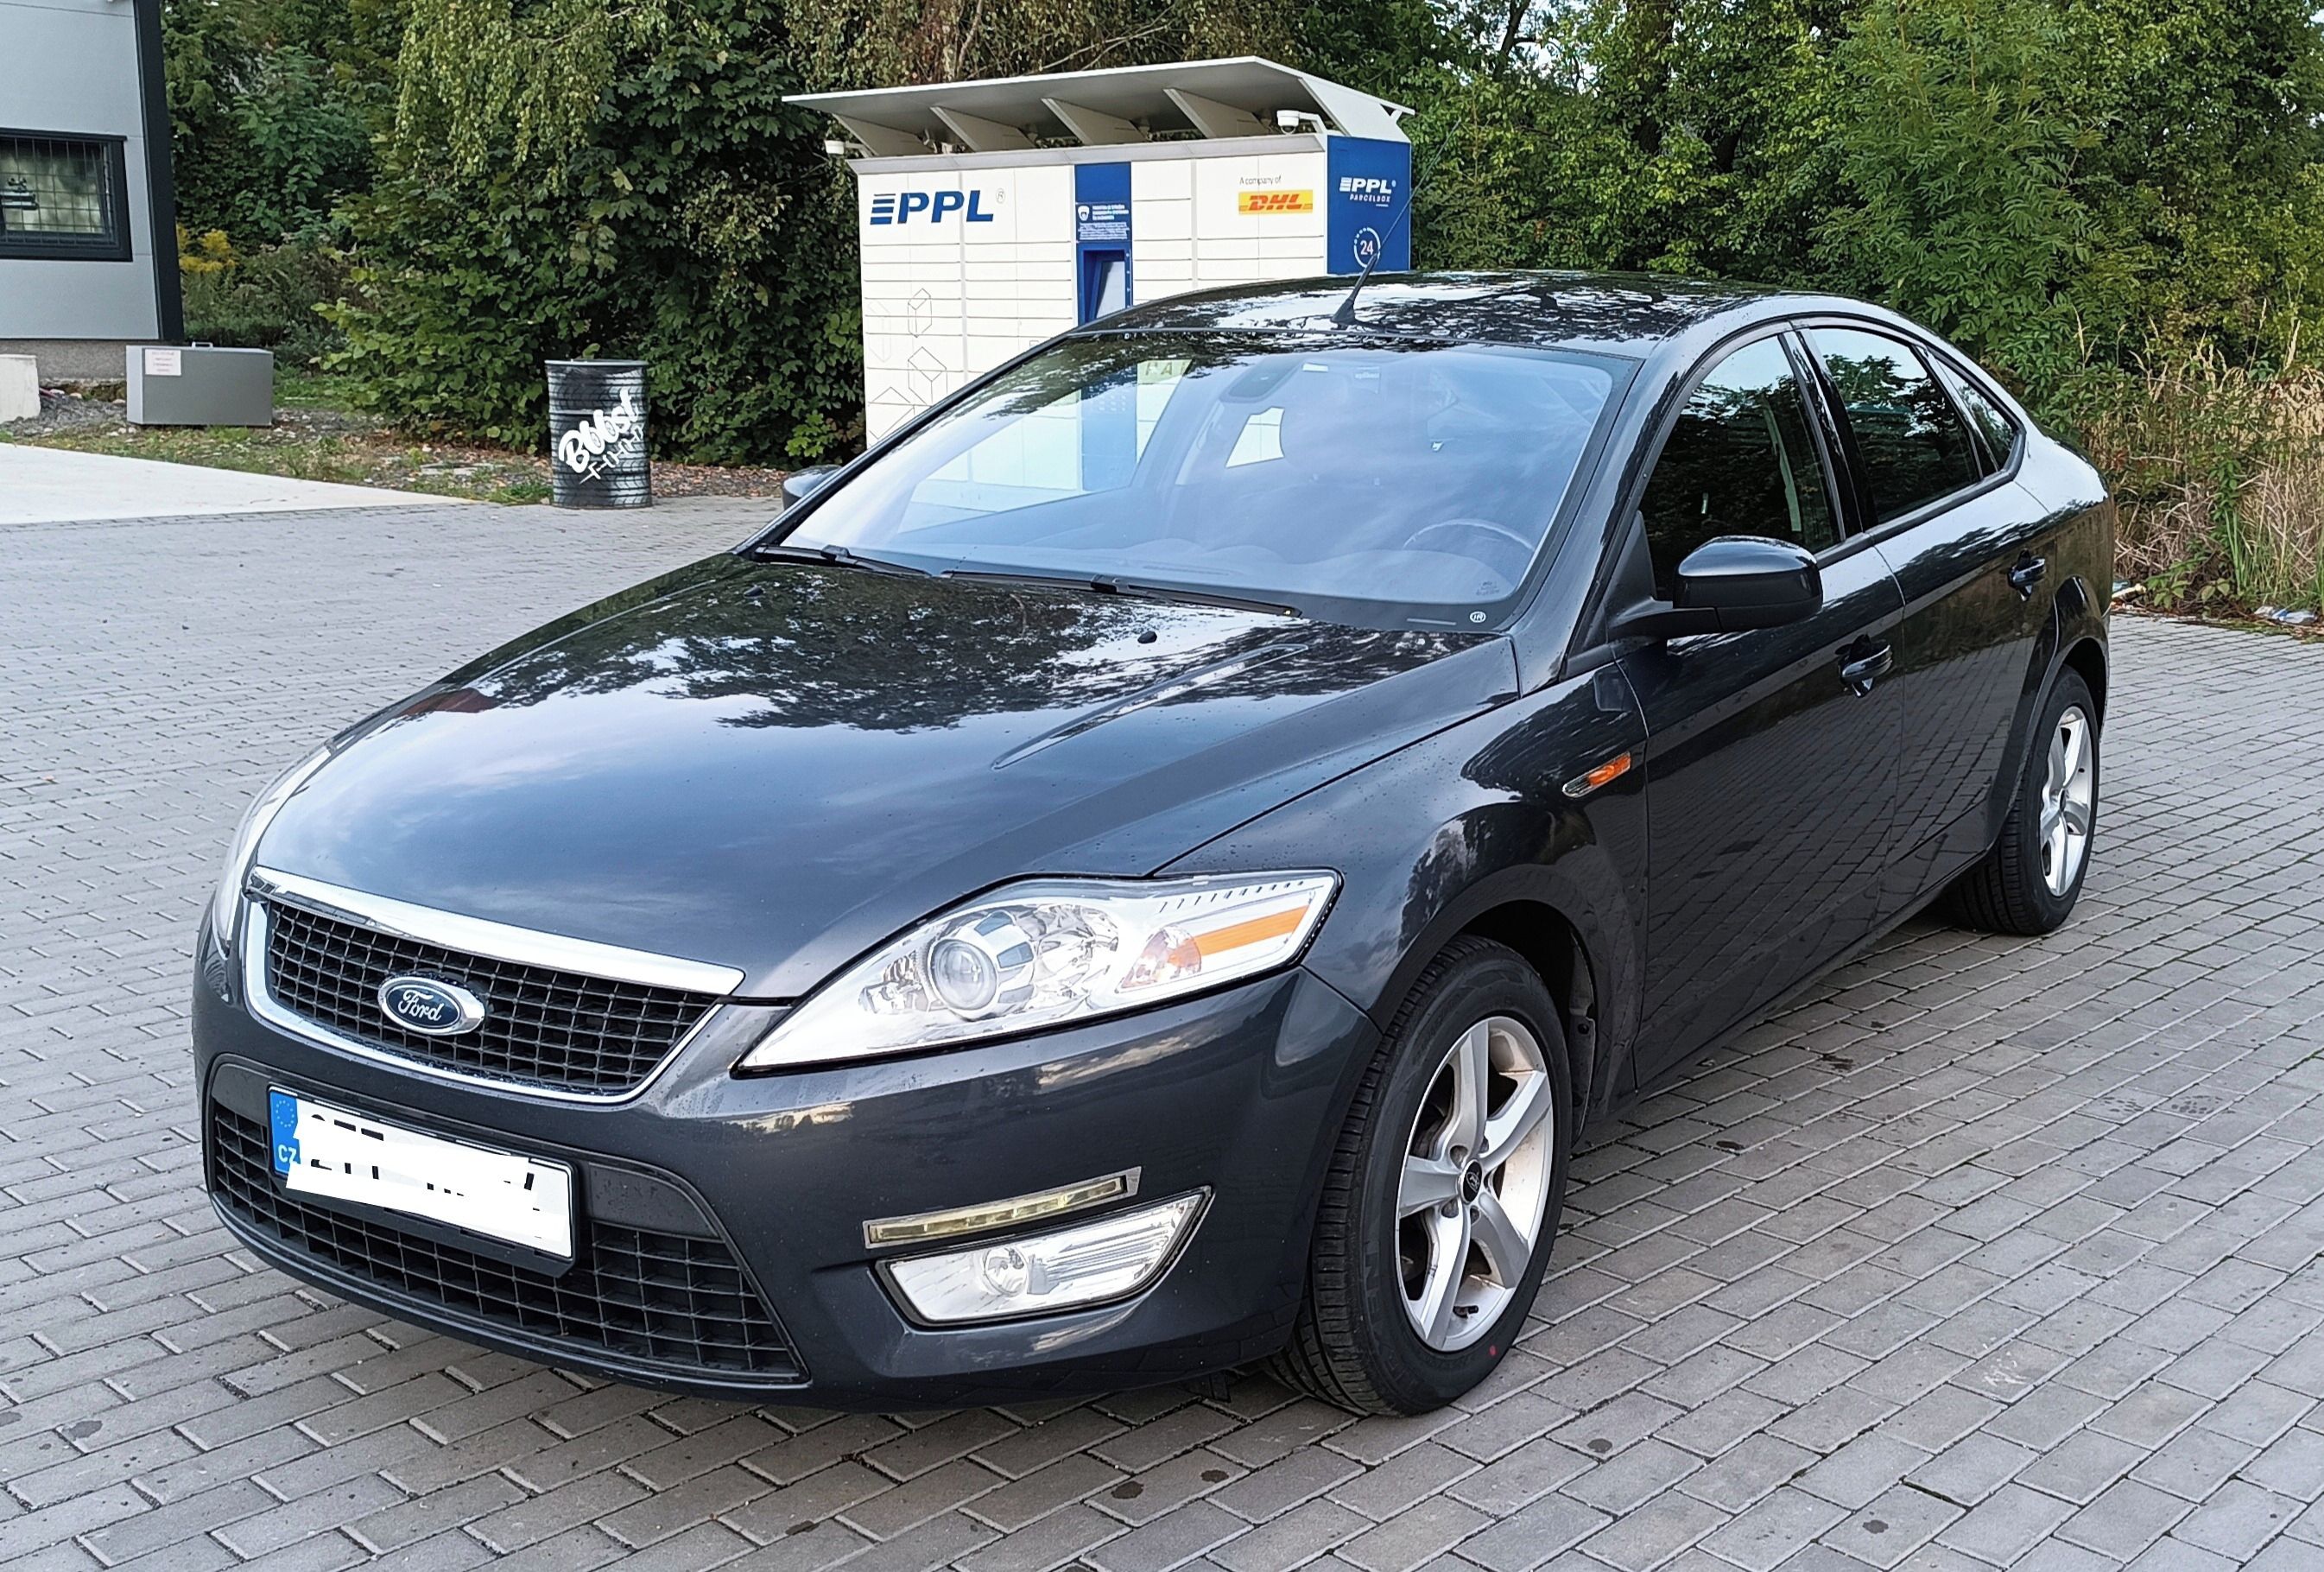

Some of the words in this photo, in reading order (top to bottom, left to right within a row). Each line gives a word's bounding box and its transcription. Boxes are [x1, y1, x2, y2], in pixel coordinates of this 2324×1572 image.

[1249, 193, 1302, 211] DHL
[1350, 193, 1390, 203] PARCELBOX
[1360, 240, 1374, 255] 24
[559, 389, 638, 473] Boost
[398, 990, 444, 1021] Ford
[278, 1144, 298, 1163] CZ
